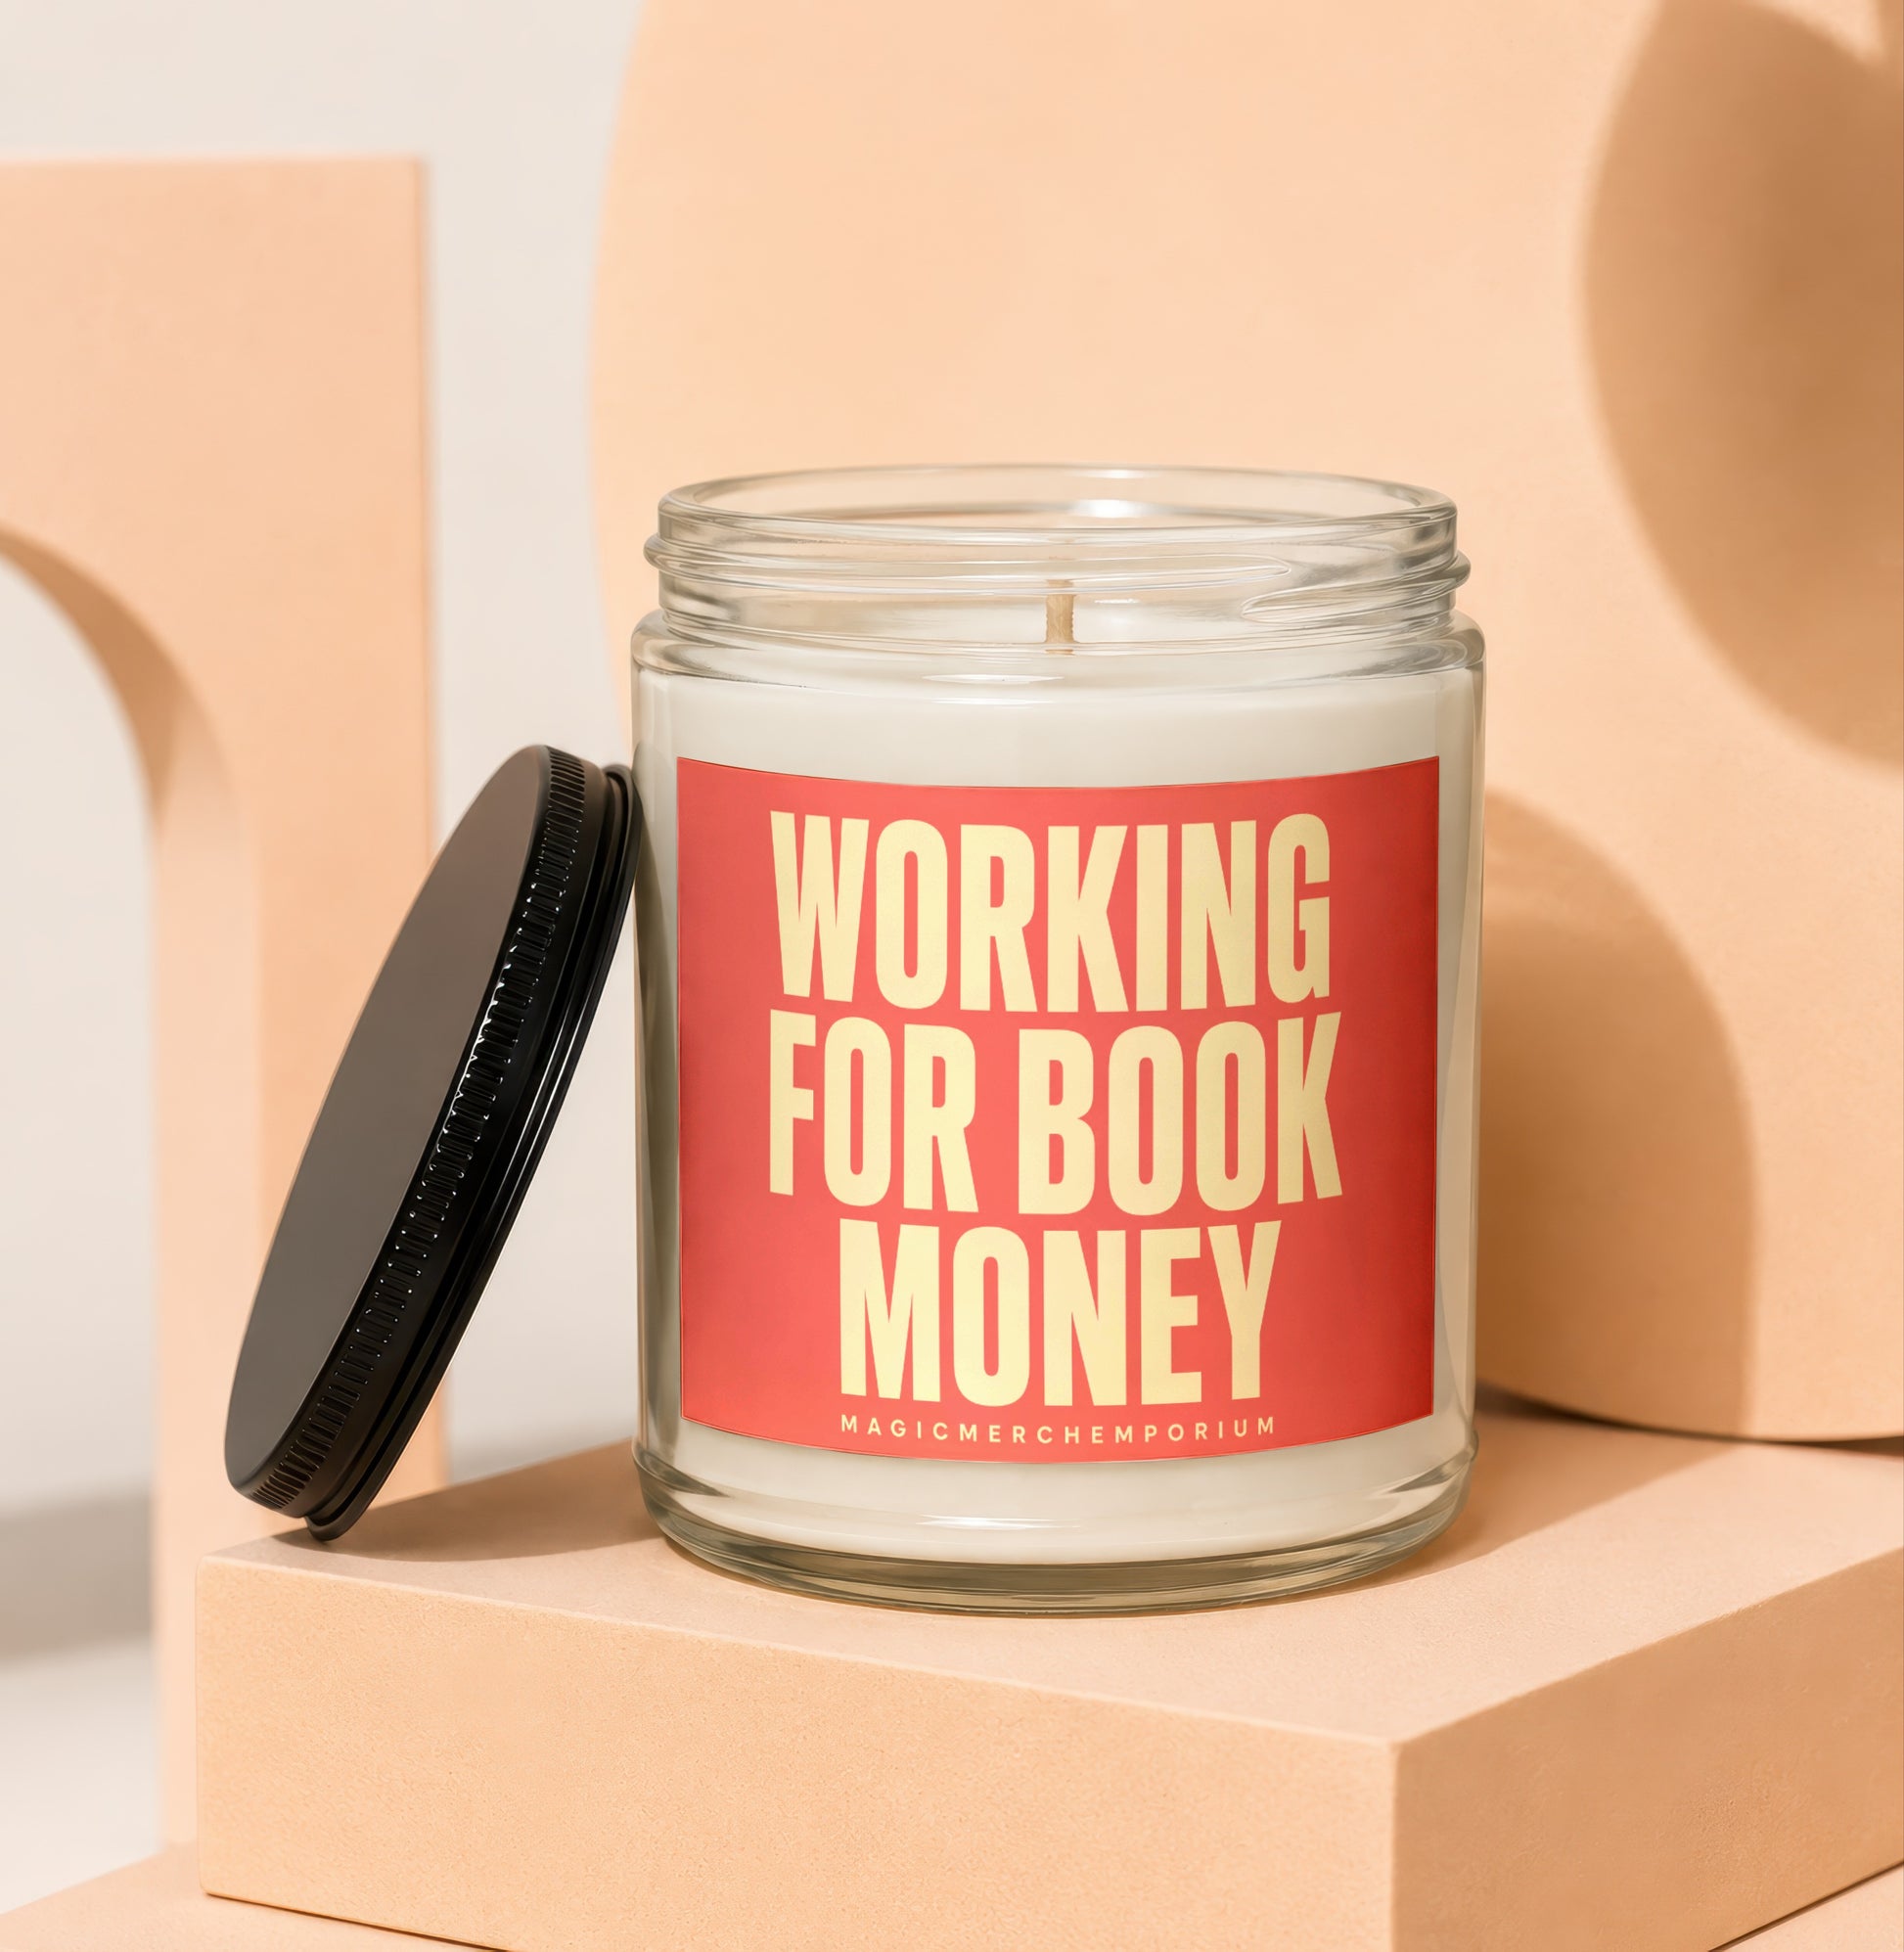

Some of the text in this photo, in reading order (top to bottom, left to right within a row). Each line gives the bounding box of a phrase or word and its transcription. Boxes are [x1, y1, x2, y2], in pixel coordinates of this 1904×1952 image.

[768, 811, 1332, 1013] WORKING
[769, 1009, 1343, 1216] FOR BOOK
[839, 1218, 1282, 1408] MONEY
[840, 1414, 1276, 1445] MAGICMERCHEMPORIUM
